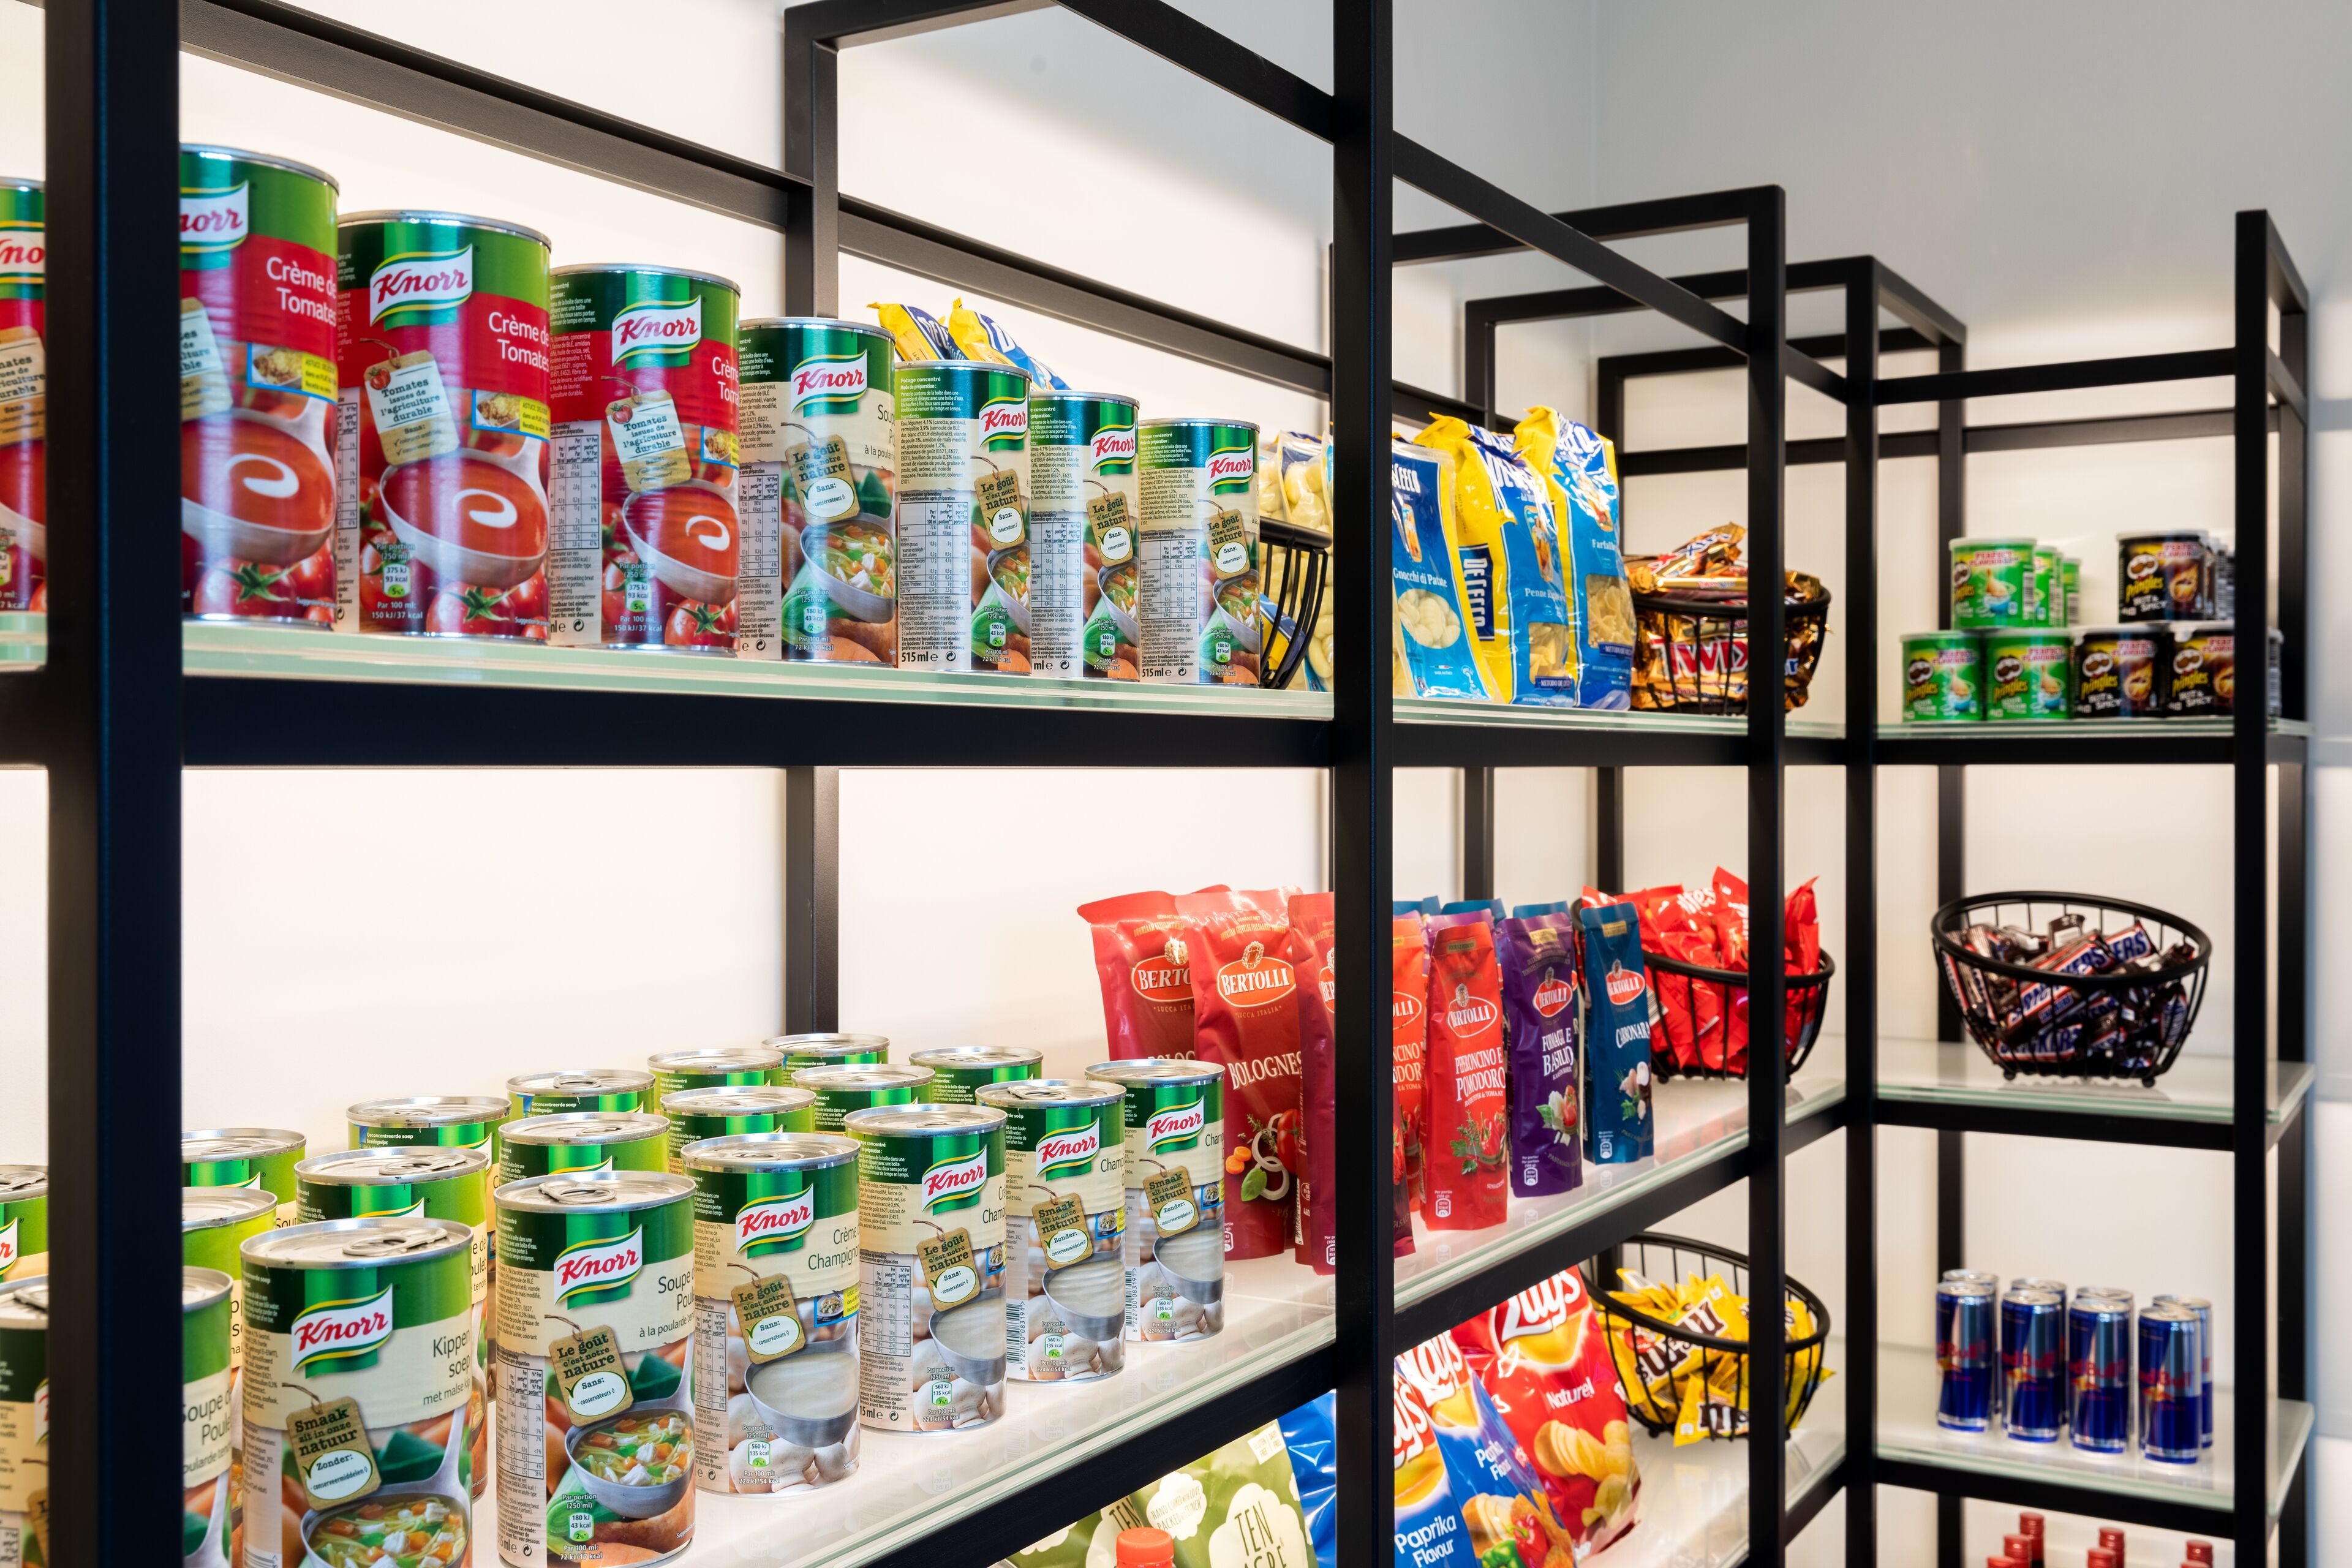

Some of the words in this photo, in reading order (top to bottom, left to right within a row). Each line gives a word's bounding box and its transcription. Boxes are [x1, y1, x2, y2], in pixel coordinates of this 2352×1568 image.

[266, 257, 325, 292] Crème
[373, 268, 468, 304] Knorr
[276, 287, 337, 327] Tomates
[489, 312, 539, 342] Crème
[614, 315, 698, 346] Knorr
[497, 339, 549, 372] Tomates
[381, 379, 429, 398] Tomates
[793, 368, 865, 396] Knorr
[380, 394, 440, 418] l'agriculture
[393, 405, 433, 423] durable
[624, 415, 668, 431] Tomates
[981, 409, 1027, 432] Knorr
[622, 429, 677, 449] l'agriculture
[631, 428, 655, 438] issues
[635, 440, 671, 455] durable
[793, 450, 810, 464] Le
[813, 442, 840, 458] goût
[1092, 435, 1134, 458] Knorr
[799, 462, 846, 483] nature
[1207, 458, 1252, 478] Knorr
[816, 483, 837, 492] Sans:
[980, 481, 994, 493] Le
[996, 477, 1015, 489] goût
[986, 492, 1000, 500] c'est
[1000, 488, 1016, 497] notre
[986, 496, 1019, 511] nature
[1092, 504, 1105, 514] Le
[1106, 497, 1125, 510] goût
[998, 512, 1013, 521] Sans:
[1096, 514, 1127, 530] nature
[1207, 522, 1220, 531] Le
[1221, 514, 1240, 527] goût
[1212, 532, 1242, 546] nature
[1393, 567, 1419, 582] Gnocchi
[1419, 573, 1427, 582] di
[1427, 573, 1448, 588] Patate
[1524, 587, 1547, 598] Penne
[902, 651, 917, 663] 515
[917, 650, 929, 662] ml
[1142, 668, 1154, 677] 515
[1155, 668, 1164, 677] ml
[1221, 968, 1290, 997] BERTOLLI
[367, 1131, 401, 1140] Geconcentreerde
[1148, 1112, 1202, 1139] Knorr
[1038, 1136, 1098, 1164] Knorr
[924, 1164, 985, 1197] Knorr
[1148, 1173, 1183, 1190] Smaak
[1169, 1181, 1185, 1191] onze
[1152, 1186, 1188, 1205] natuur
[1038, 1200, 1076, 1218] Smaak
[1041, 1216, 1051, 1225] zit
[1061, 1209, 1077, 1219] onze
[1163, 1200, 1185, 1214] Zonder:
[737, 1205, 811, 1238] Knorr
[1041, 1214, 1080, 1234] natuur
[833, 1224, 857, 1245] Crème
[1054, 1231, 1077, 1243] Zonder:
[923, 1246, 939, 1256] Le
[941, 1235, 965, 1250] goût
[929, 1253, 946, 1263] c'est
[946, 1245, 965, 1256] notre
[1050, 1240, 1084, 1256] conserveermiddelen
[556, 1248, 639, 1287] Knorr
[929, 1250, 969, 1273] nature
[657, 1272, 691, 1294] Soupe
[943, 1270, 961, 1281] Sans:
[737, 1292, 754, 1303] Le
[757, 1280, 784, 1297] goût
[942, 1280, 967, 1294] conservateurs
[743, 1299, 762, 1311] c'est
[763, 1292, 785, 1303] notre
[744, 1298, 790, 1322] nature
[294, 1311, 390, 1352] Knorr
[639, 1327, 645, 1338] à
[647, 1325, 657, 1336] la
[657, 1316, 687, 1340] poularde
[760, 1319, 781, 1332] Sans:
[432, 1328, 470, 1359] Kippen
[556, 1346, 575, 1359] Le
[578, 1333, 609, 1351] goût
[758, 1331, 786, 1346] conservateurs
[448, 1355, 471, 1379] soep
[563, 1355, 584, 1368] c'est
[586, 1347, 611, 1359] notre
[564, 1353, 616, 1379] nature
[581, 1376, 605, 1390] Sans:
[423, 1392, 443, 1406] met
[443, 1383, 464, 1400] malse
[579, 1390, 612, 1406] conservateurs
[1546, 1378, 1595, 1410] Naturel
[294, 1409, 350, 1433] Smaak
[298, 1431, 312, 1443] zit
[313, 1429, 325, 1440] in
[326, 1421, 352, 1434] onze
[298, 1428, 358, 1457] natuur
[315, 1452, 353, 1471] Zonder:
[312, 1467, 365, 1492] conserveermiddelen
[573, 1493, 598, 1502] portion
[579, 1521, 592, 1529] kcal
[1235, 1501, 1273, 1556] TEN
[1395, 1515, 1457, 1555] Paprika
[1412, 1538, 1455, 1568] Flavour
